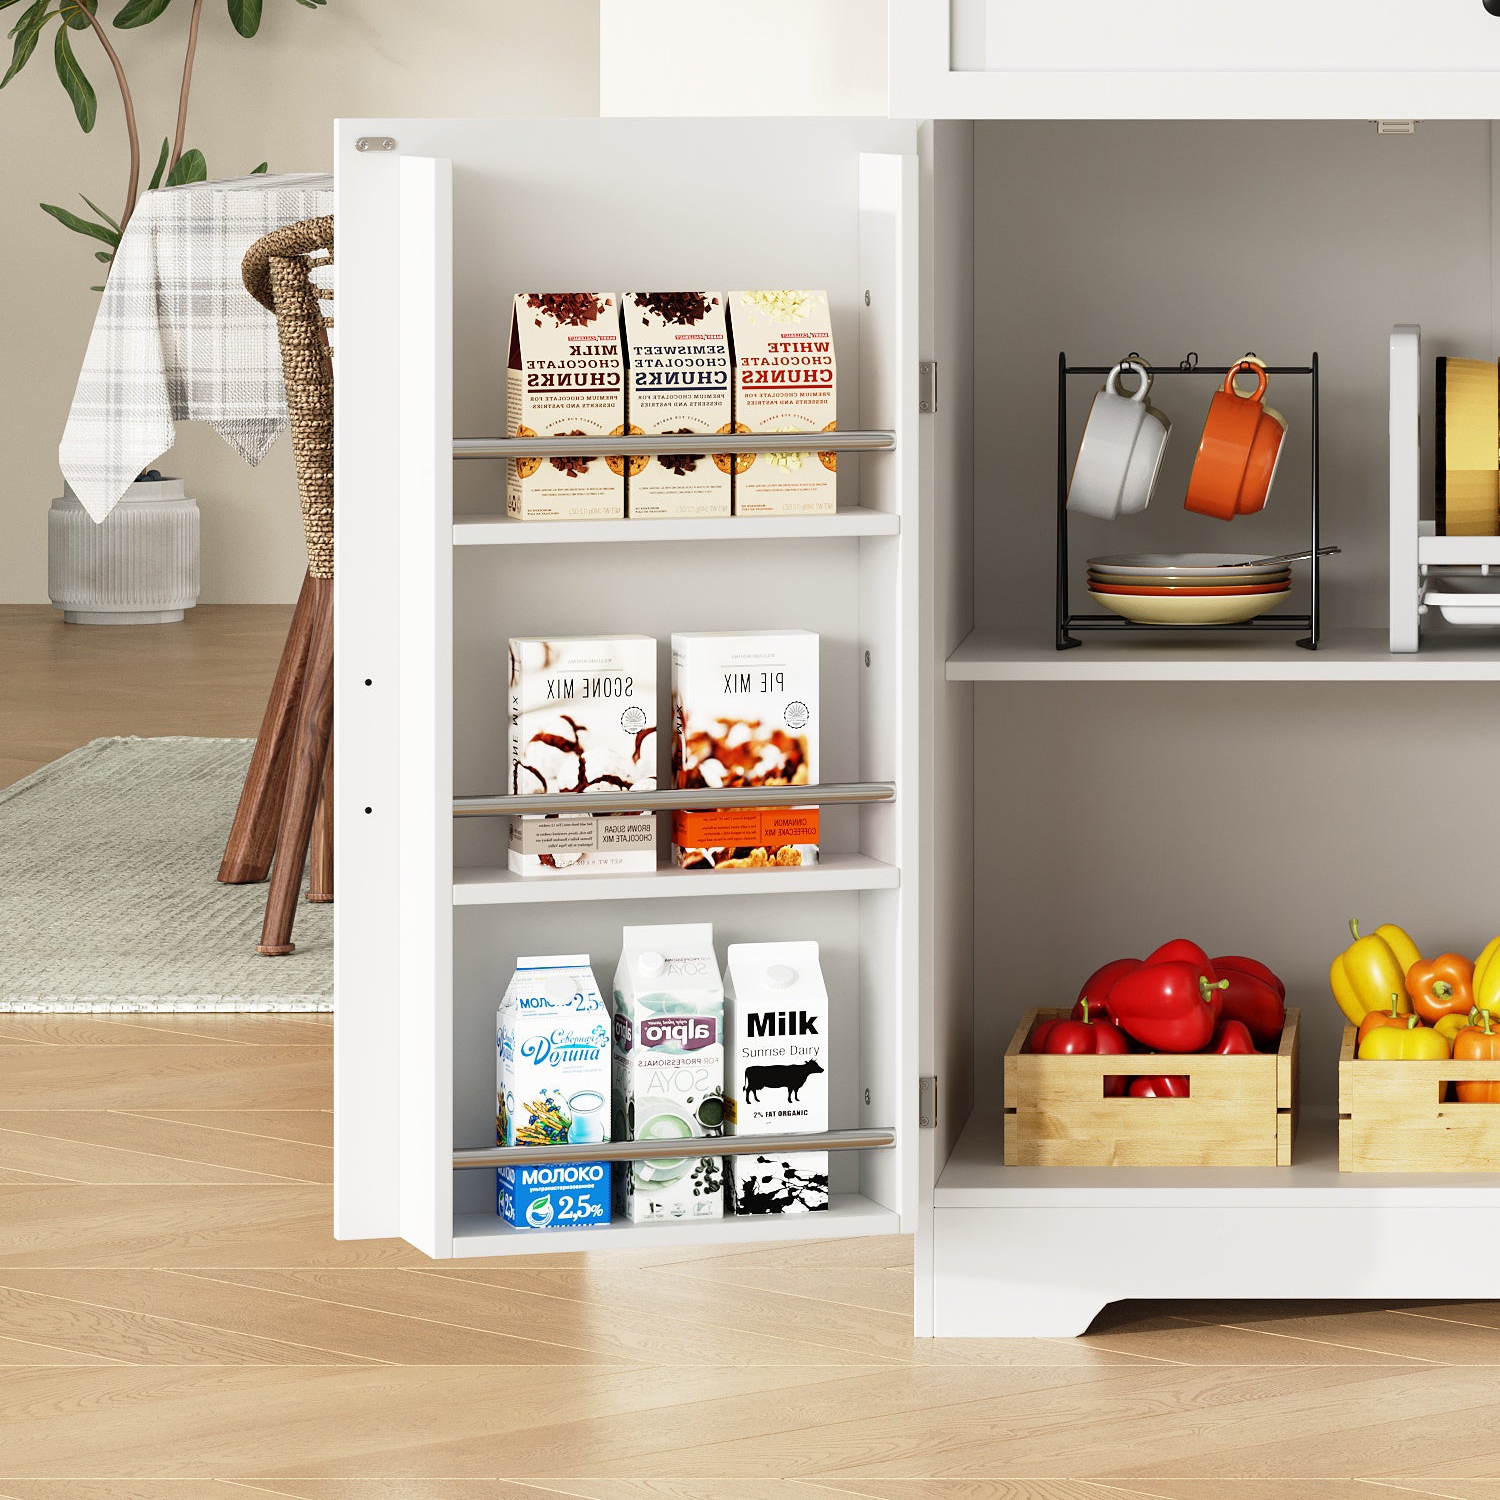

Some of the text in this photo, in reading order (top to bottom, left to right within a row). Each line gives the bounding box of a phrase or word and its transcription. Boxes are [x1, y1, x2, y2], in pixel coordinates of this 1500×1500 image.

[747, 1010, 819, 1038] Milk
[520, 1036, 601, 1067] Долина
[742, 1046, 820, 1058] Sunrise Dairy
[522, 1166, 604, 1185] МОЛОКО
[558, 1194, 604, 1222] 2,5%
